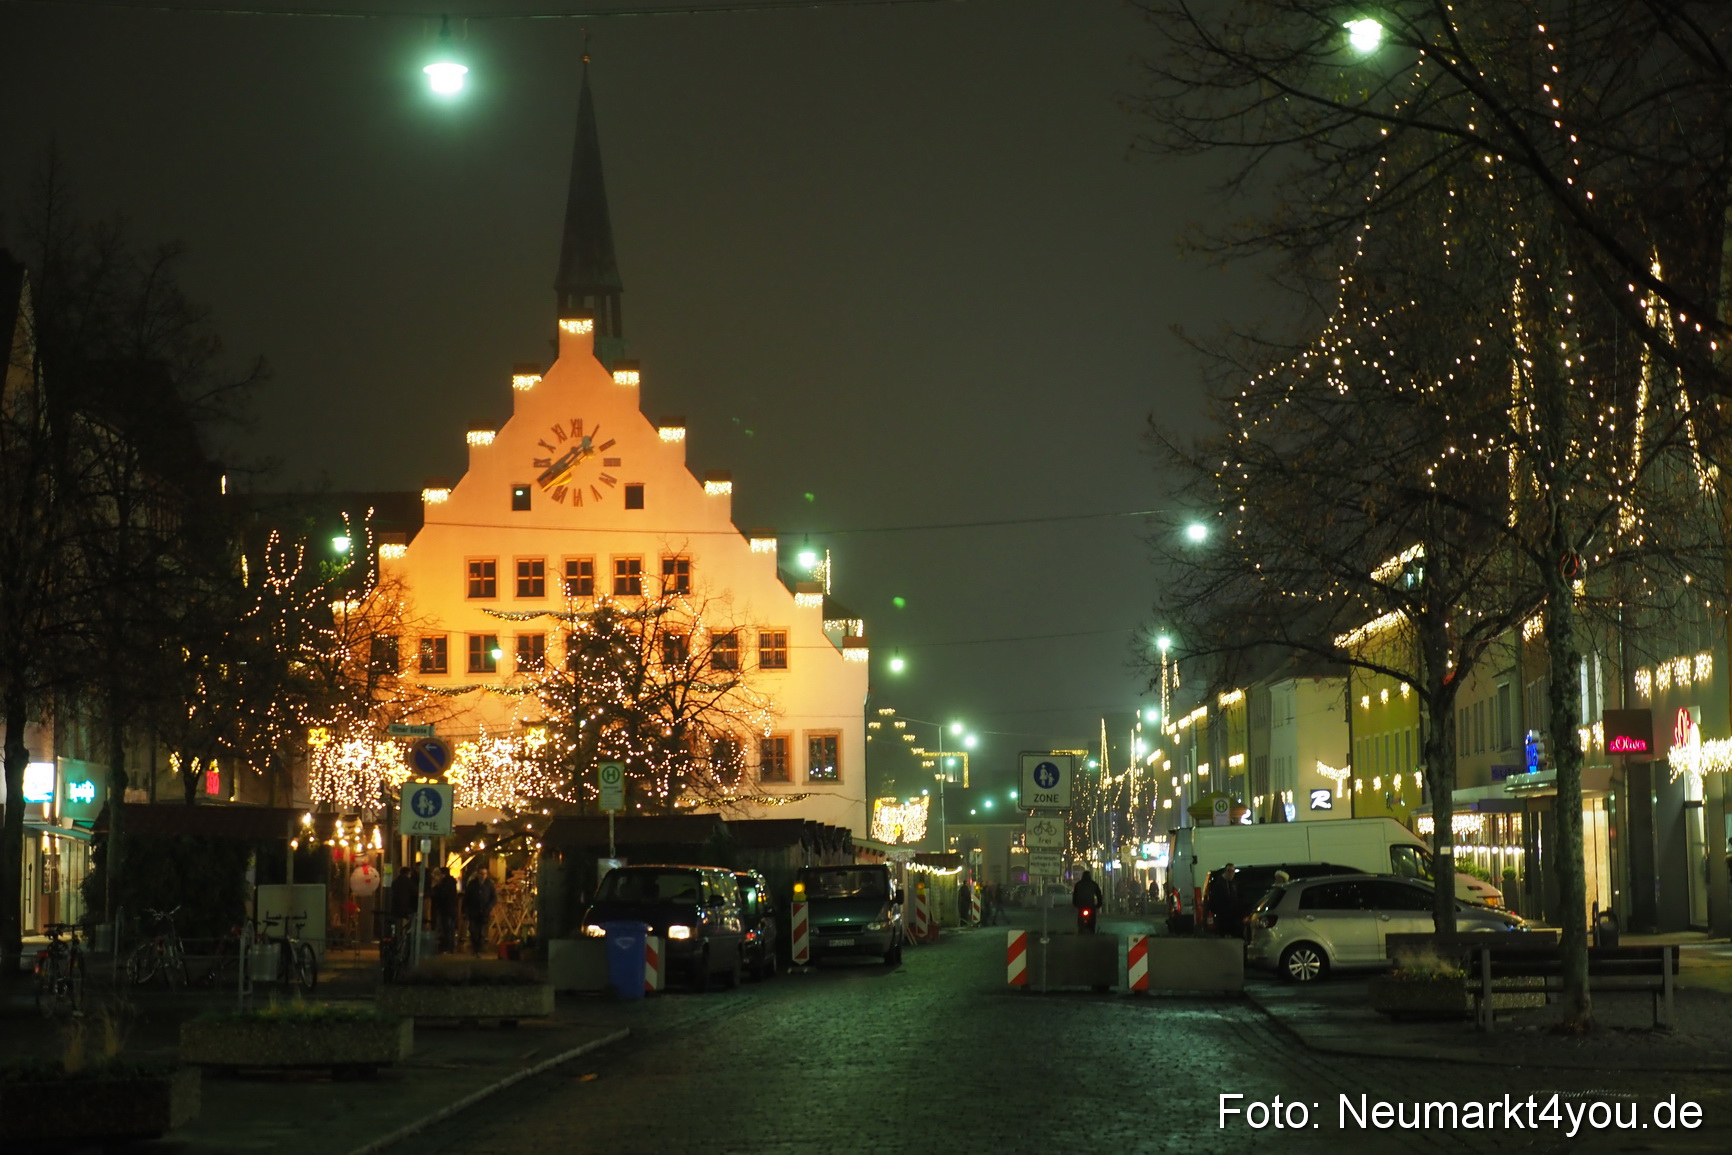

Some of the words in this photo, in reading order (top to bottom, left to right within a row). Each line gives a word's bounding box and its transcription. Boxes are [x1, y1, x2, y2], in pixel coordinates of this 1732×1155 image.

[606, 769, 616, 780] H
[1033, 794, 1060, 803] ZONE
[1311, 790, 1332, 809] R
[1038, 837, 1052, 845] frei
